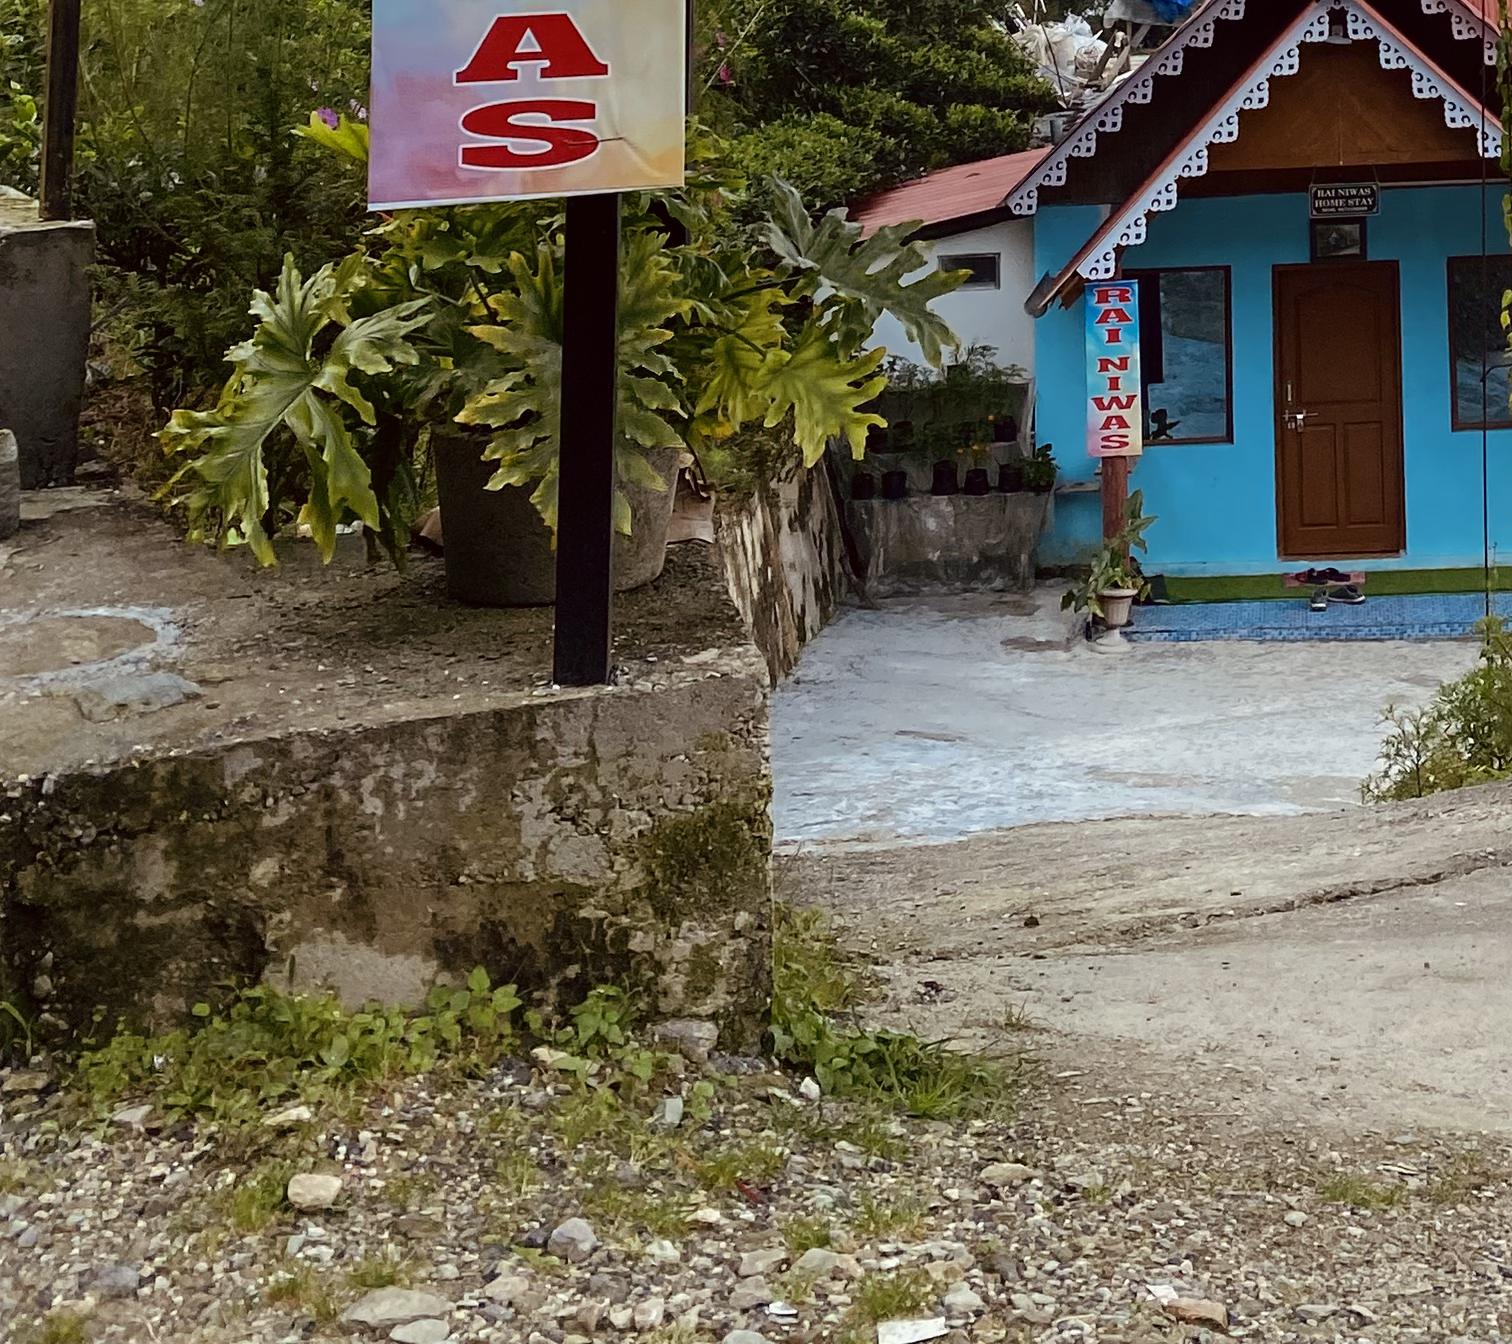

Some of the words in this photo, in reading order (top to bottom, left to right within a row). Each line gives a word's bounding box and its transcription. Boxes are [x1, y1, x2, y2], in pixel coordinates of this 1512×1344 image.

[1315, 198, 1346, 208] HOME
[1347, 197, 1374, 207] STAY
[1338, 187, 1371, 197] NIWAS
[1094, 286, 1134, 345] RAI
[1090, 356, 1138, 450] NIWAS
